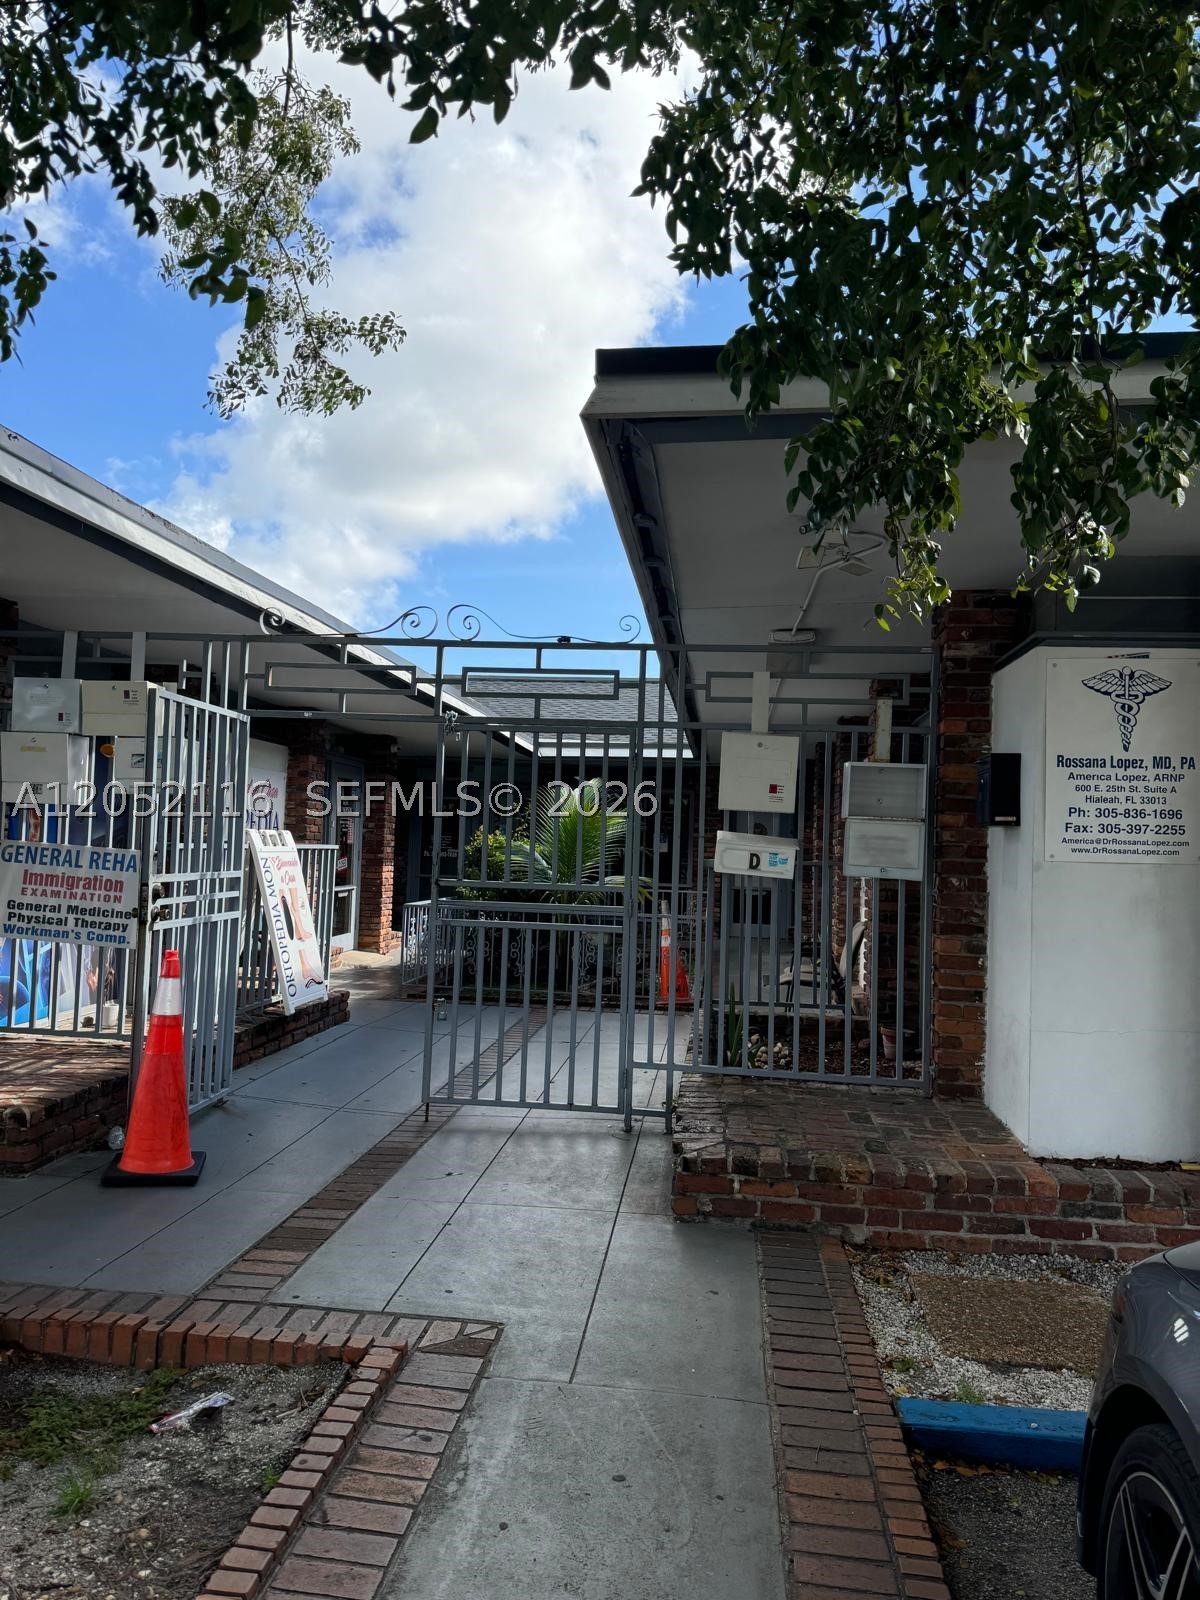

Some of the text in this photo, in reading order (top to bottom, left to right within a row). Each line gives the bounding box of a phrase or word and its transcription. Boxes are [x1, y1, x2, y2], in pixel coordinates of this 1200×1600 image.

[1056, 755, 1196, 771] Rossana Lopez, MD, PA
[1067, 772, 1186, 783] America Lopez, ARNP
[1105, 785, 1126, 793] 25th
[1128, 785, 1141, 793] St.
[1143, 785, 1168, 794] Suite
[1170, 786, 1177, 794] A
[1085, 795, 1167, 805] Hialeah, FL 33013
[1068, 807, 1183, 820] Ph: 305-836-1696
[1065, 822, 1186, 836] Fax: 305-397-2255
[1061, 837, 1190, 847] America@DrRossanaLopez.com
[1, 844, 137, 872] GENERAL REHA
[1070, 846, 1180, 856] www.DrRossanaLopez.com
[750, 853, 761, 869] D
[22, 869, 124, 893] Immigration
[21, 887, 122, 904] EXAMINATION
[7, 900, 132, 920] General Medicine
[7, 912, 129, 932] Physical Therapy
[260, 857, 297, 997] ORTOPEDIA MON
[3, 923, 130, 945] Workman's Comp.
